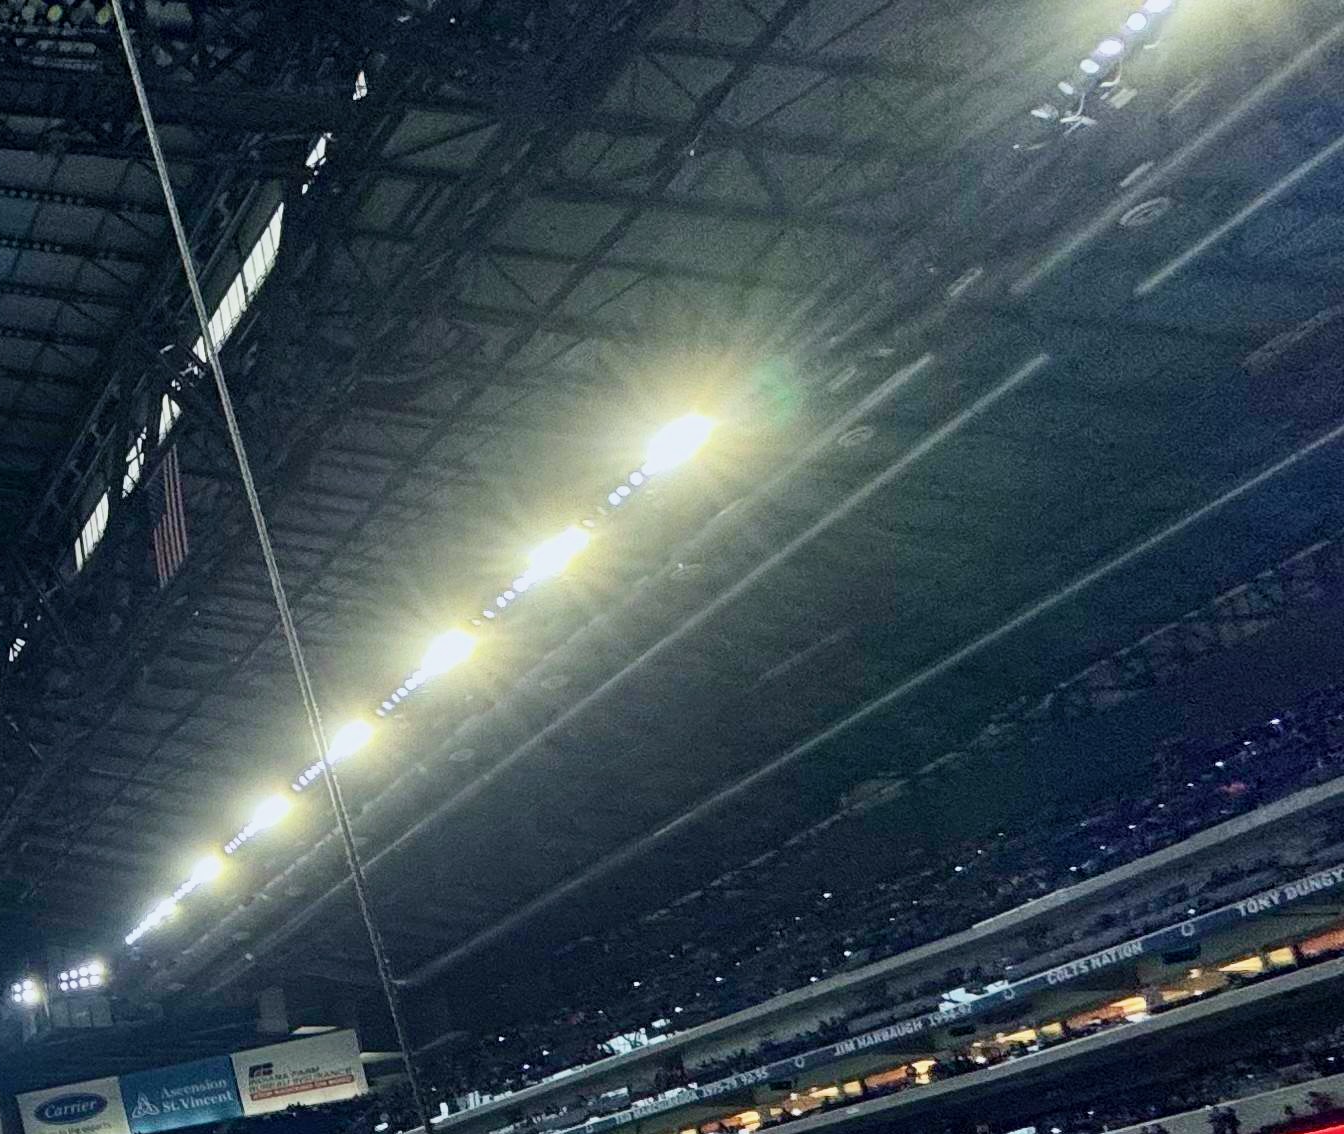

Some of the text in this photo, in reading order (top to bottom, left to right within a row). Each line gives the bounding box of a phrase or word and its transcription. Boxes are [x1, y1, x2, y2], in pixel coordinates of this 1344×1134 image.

[1236, 889, 1281, 918] TONY
[1047, 942, 1143, 985] COLTS NATION
[161, 1078, 228, 1099] Ascension
[44, 1099, 98, 1119] Carrier
[181, 1090, 233, 1110] Vincent
